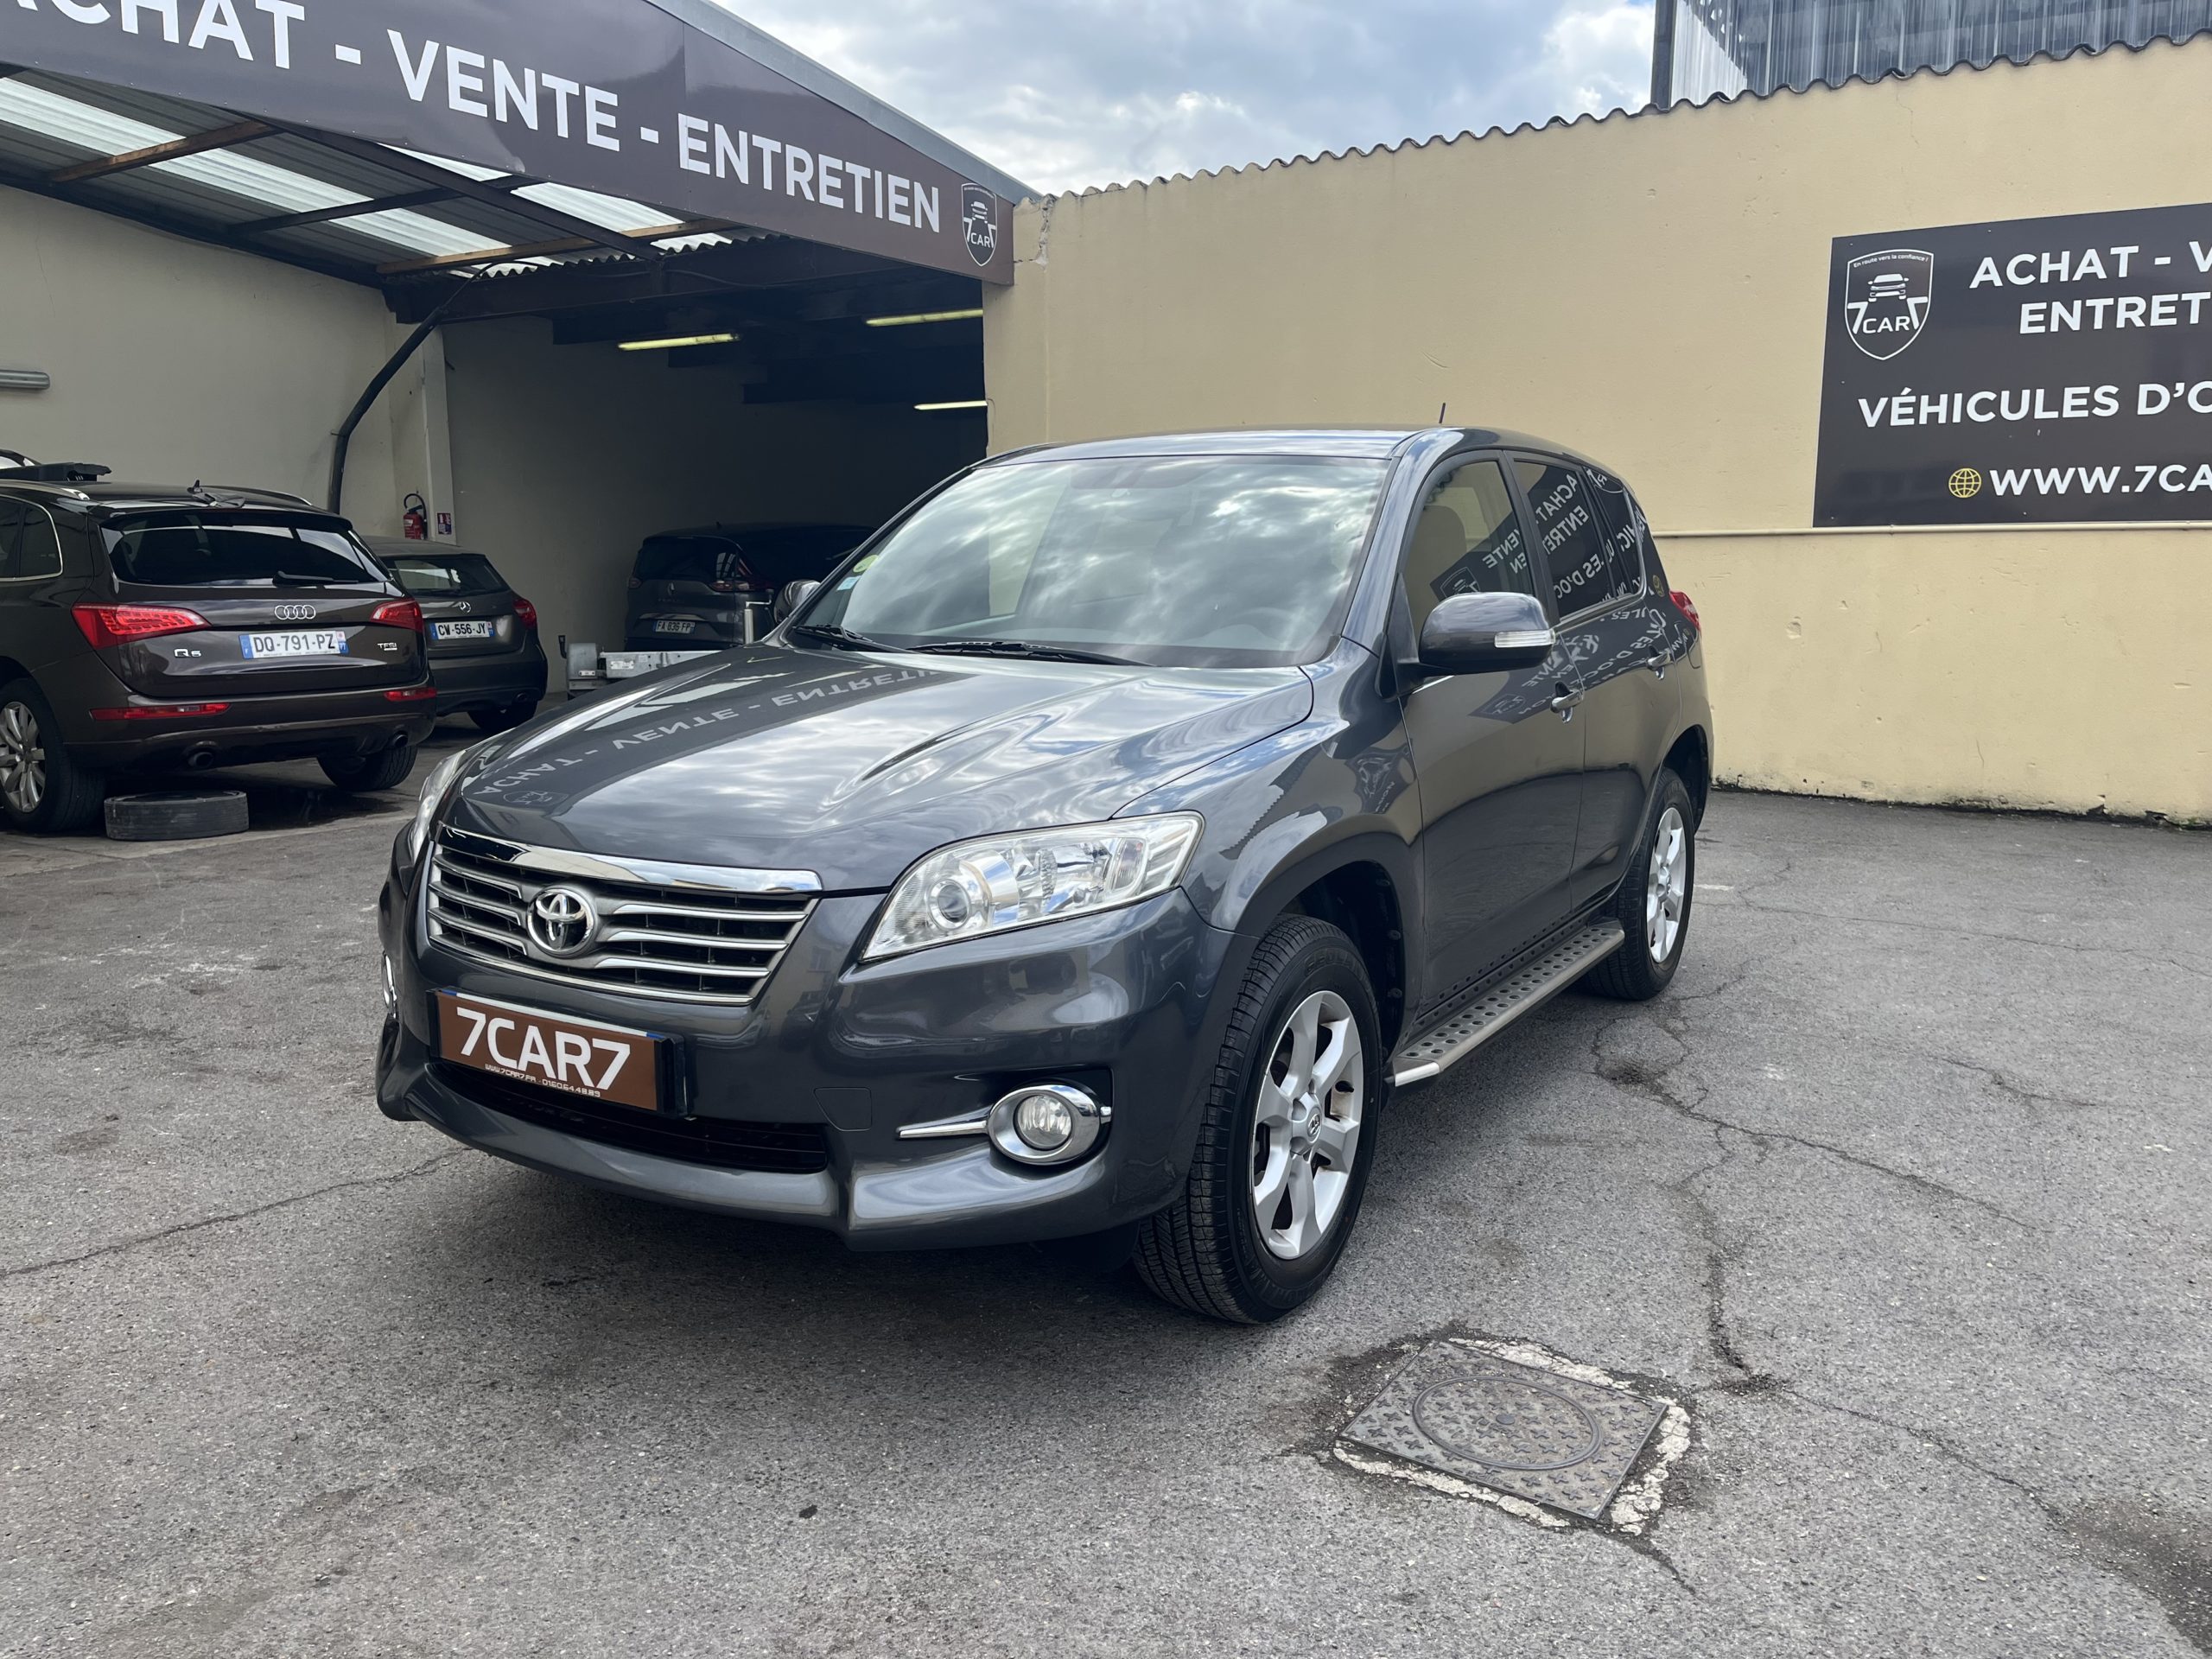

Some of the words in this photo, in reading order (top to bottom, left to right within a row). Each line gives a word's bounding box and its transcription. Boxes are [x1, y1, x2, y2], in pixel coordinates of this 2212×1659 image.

[16, 0, 304, 69] HAT
[387, 29, 620, 152] VENTE
[677, 112, 940, 233] ENTRETIEN
[1897, 253, 1925, 262] confiance
[1969, 245, 2139, 289] ACHAT
[2019, 291, 2211, 334] ENTRET
[1858, 385, 2120, 428] VÉHICULES
[1989, 464, 2212, 496] WWW.7CA
[253, 633, 335, 652] DQ-791-PZ
[456, 1007, 631, 1090] 7CAR7
